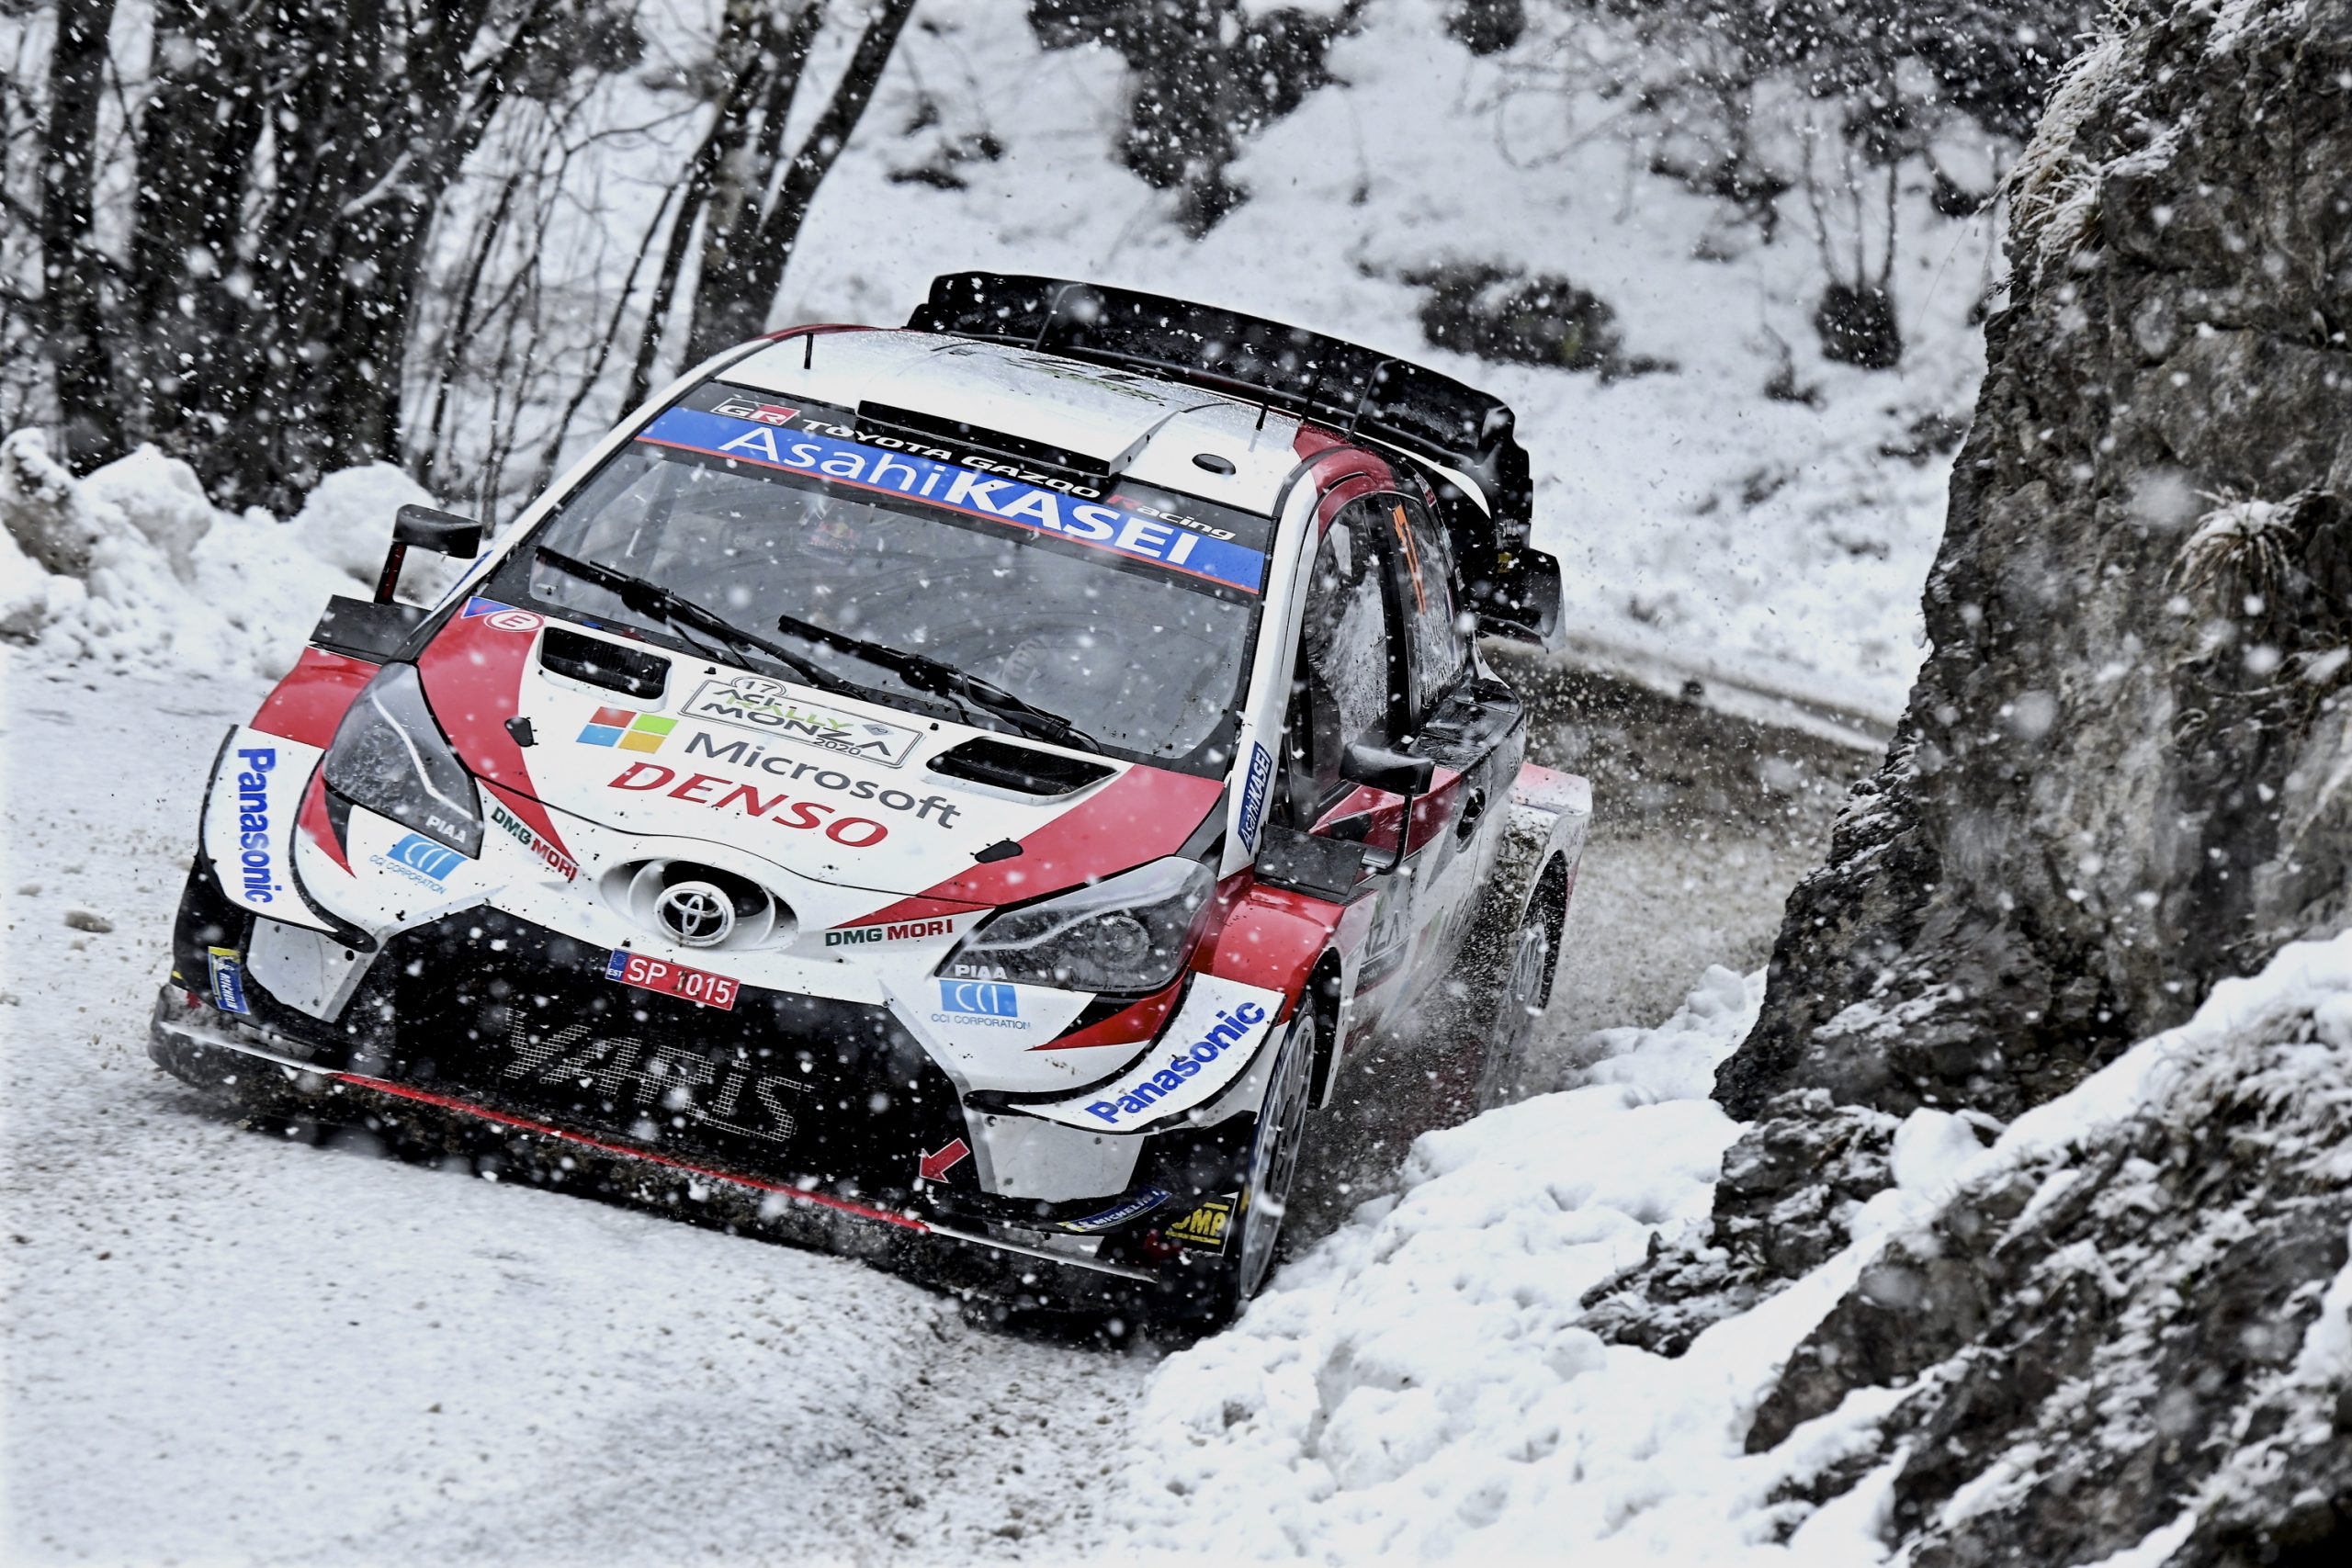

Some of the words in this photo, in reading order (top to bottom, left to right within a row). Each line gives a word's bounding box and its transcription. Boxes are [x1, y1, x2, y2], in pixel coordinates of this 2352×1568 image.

[803, 419, 952, 459] TOYOTA
[961, 457, 1100, 498] GAZOO
[1106, 495, 1236, 540] Racing
[746, 682, 777, 694] 17
[701, 703, 891, 756] MONZA
[813, 738, 862, 756] 2020
[684, 732, 962, 829] Microsoft
[238, 749, 282, 903] Panasonic
[607, 761, 888, 848] DENSO
[426, 815, 467, 843] PIAA
[491, 807, 531, 845] DMG
[530, 838, 578, 881] MORI
[387, 862, 447, 895] CORPORATION
[826, 928, 882, 946] DMG
[888, 919, 953, 941] MORI
[608, 968, 624, 978] EST
[628, 958, 668, 986] SP
[675, 969, 732, 1005] 1015
[955, 964, 1007, 979] PIAA
[932, 1013, 950, 1023] CCI
[955, 1016, 1031, 1030] CORPORATION
[505, 1007, 814, 1143] YARIS
[1084, 1002, 1264, 1124] Panasonic
